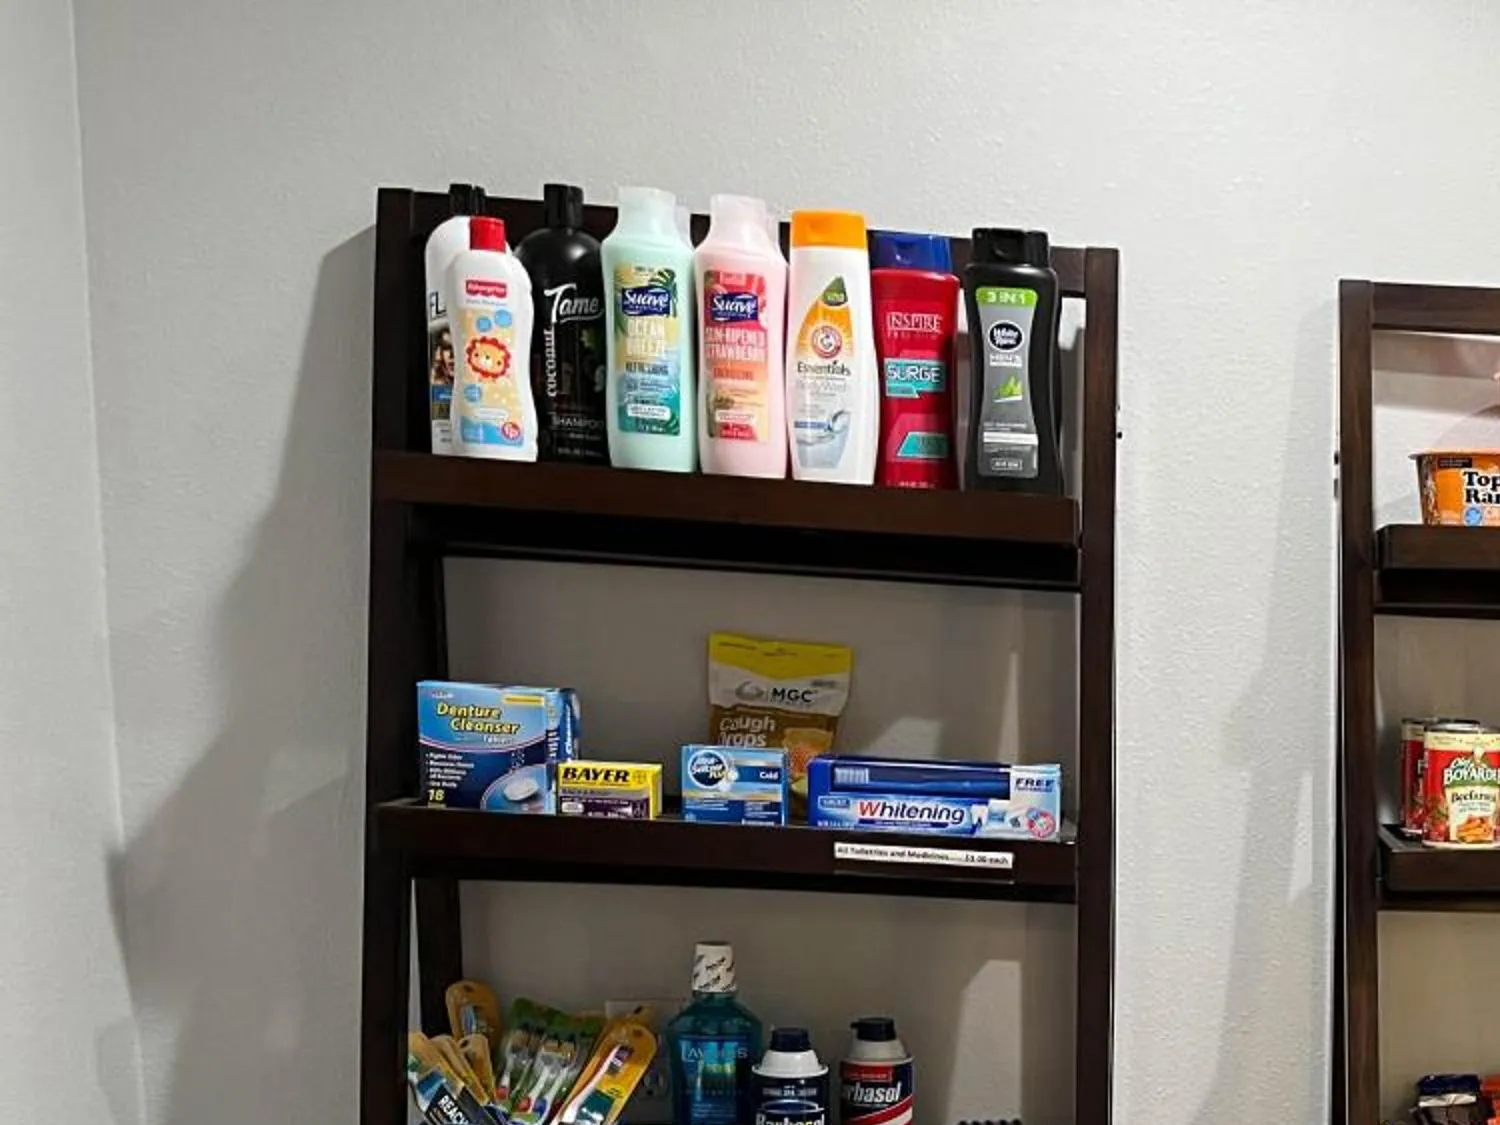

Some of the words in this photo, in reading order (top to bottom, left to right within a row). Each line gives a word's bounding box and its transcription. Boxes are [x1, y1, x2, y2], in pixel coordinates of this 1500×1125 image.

[544, 283, 600, 322] Tame
[623, 288, 670, 309] Suave
[712, 294, 758, 319] Suave
[887, 312, 943, 331] INSPIRE
[544, 328, 557, 397] coconut
[886, 365, 942, 384] SURGE
[771, 686, 813, 703] MGC
[436, 702, 502, 720] Denture
[450, 717, 520, 736] Cleanser
[719, 715, 775, 734] Cough
[561, 767, 631, 783] BAYER
[759, 771, 779, 780] Cold
[1015, 777, 1055, 789] FREE
[858, 799, 965, 826] Whitening
[845, 1081, 902, 1104] rbasol
